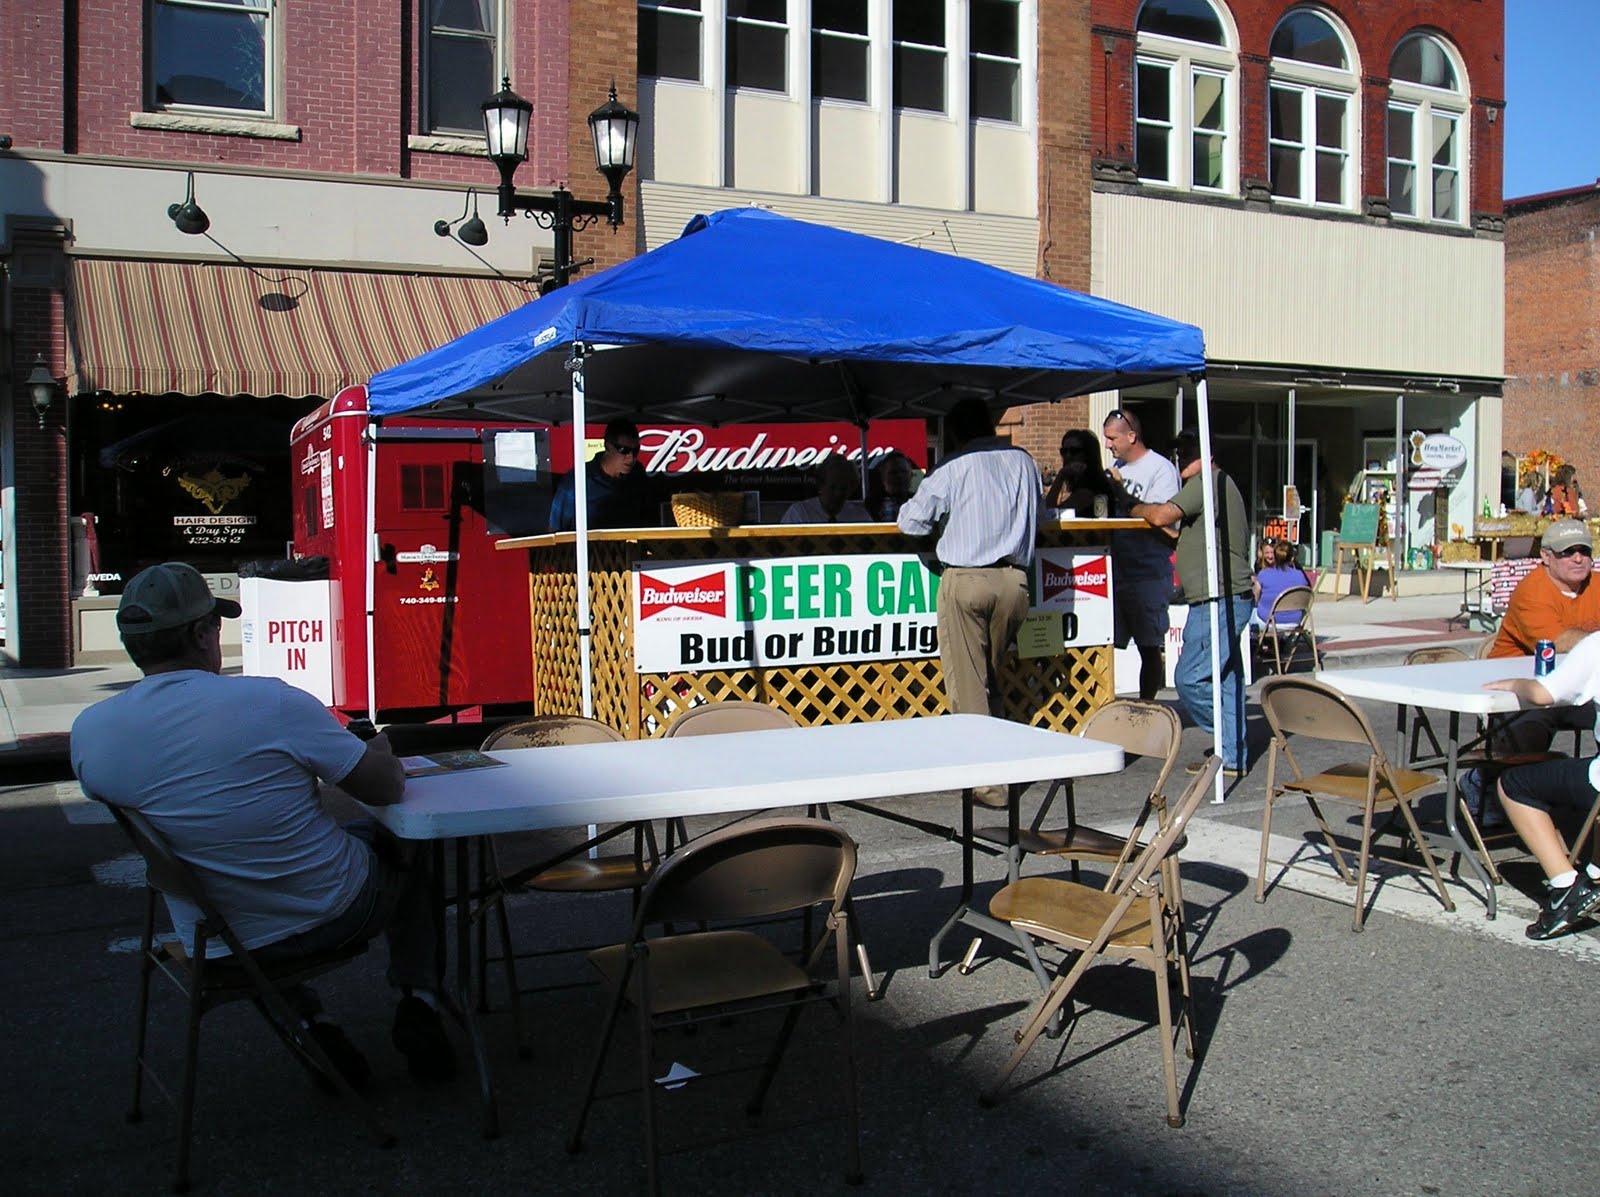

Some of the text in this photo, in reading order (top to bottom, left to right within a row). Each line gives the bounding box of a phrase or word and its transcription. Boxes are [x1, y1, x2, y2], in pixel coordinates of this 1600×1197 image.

[195, 526, 220, 536] Day
[222, 525, 246, 536] Spa
[86, 573, 122, 582] AVEDA
[1043, 571, 1107, 587] Budweiser
[641, 587, 725, 605] Budweiser
[736, 563, 852, 622] BEER
[268, 620, 324, 644] PITCH
[1169, 627, 1183, 643] PIT
[680, 621, 938, 665] Bud or Bud Lig
[287, 648, 307, 671] IN
